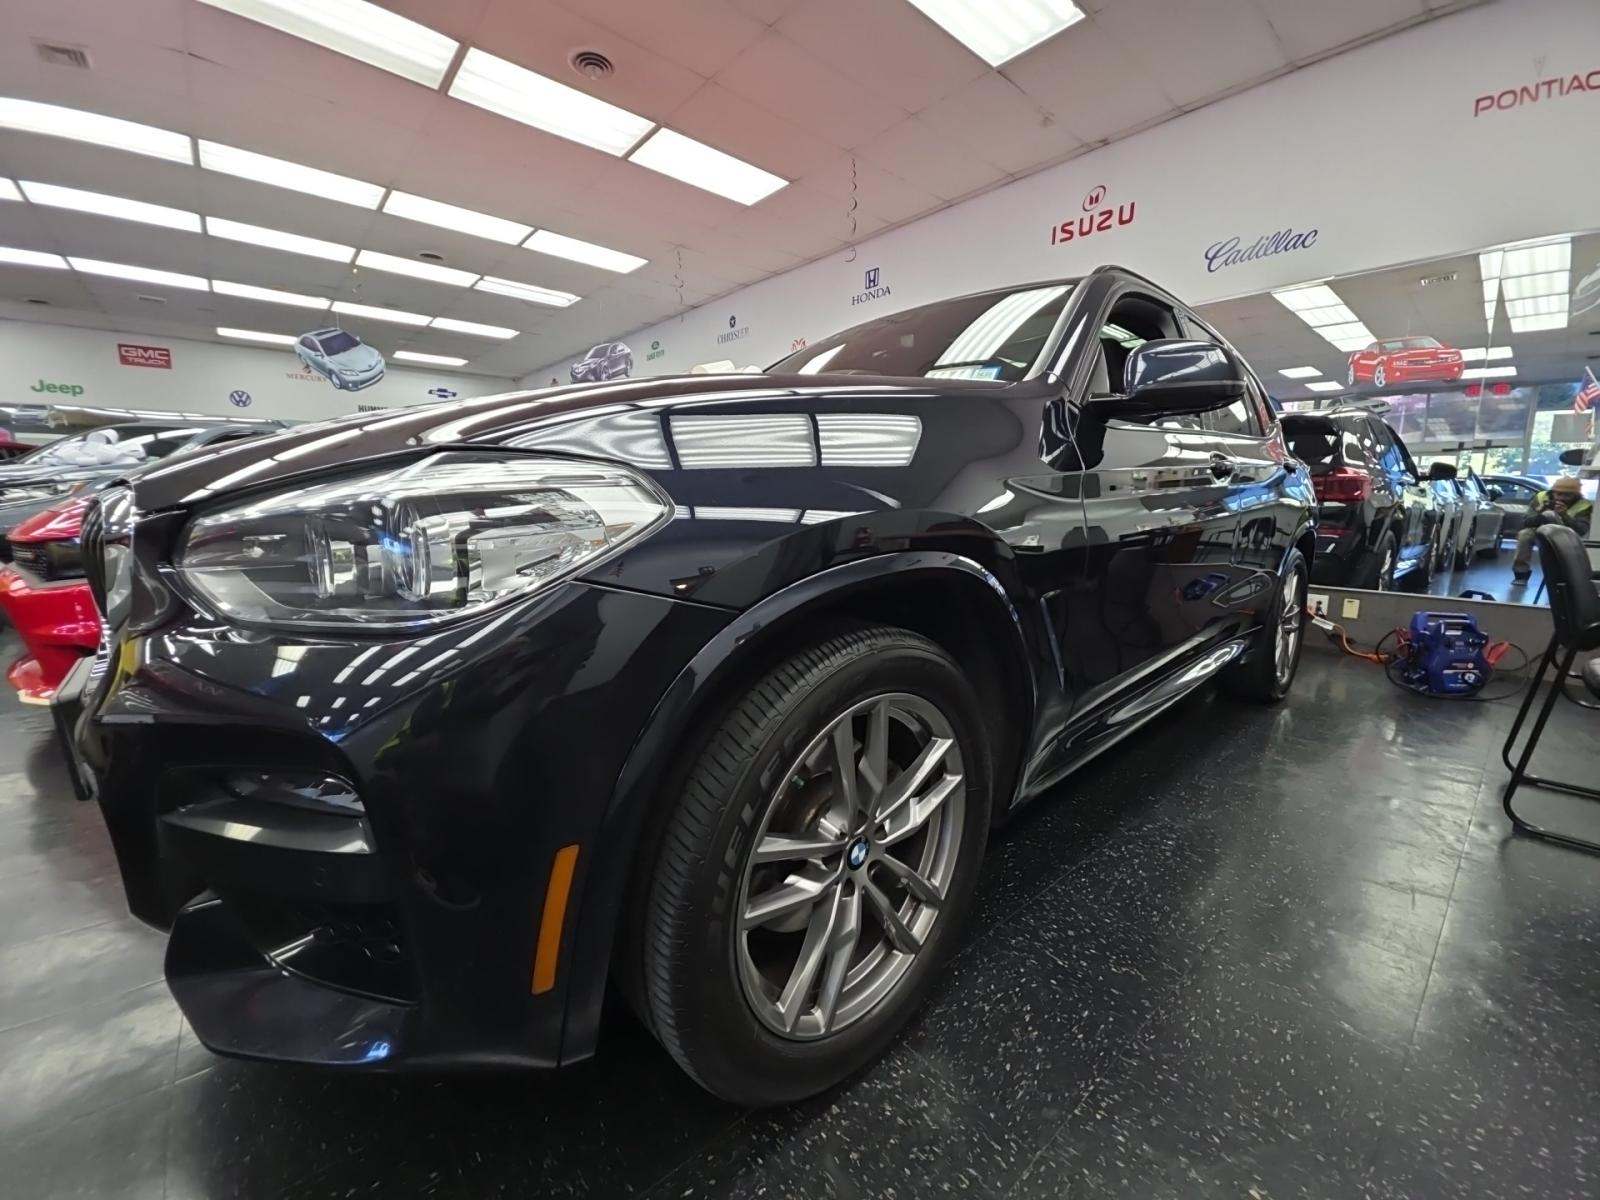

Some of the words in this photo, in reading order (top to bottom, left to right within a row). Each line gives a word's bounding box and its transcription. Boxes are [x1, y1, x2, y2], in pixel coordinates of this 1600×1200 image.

[1474, 70, 1600, 117] PONTIAC
[1051, 202, 1135, 245] ISUZU
[1204, 228, 1319, 273] Cadillac
[852, 285, 891, 305] HONDA
[120, 346, 169, 360] GMC
[126, 356, 168, 366] TRUCK
[30, 379, 84, 397] Jeep
